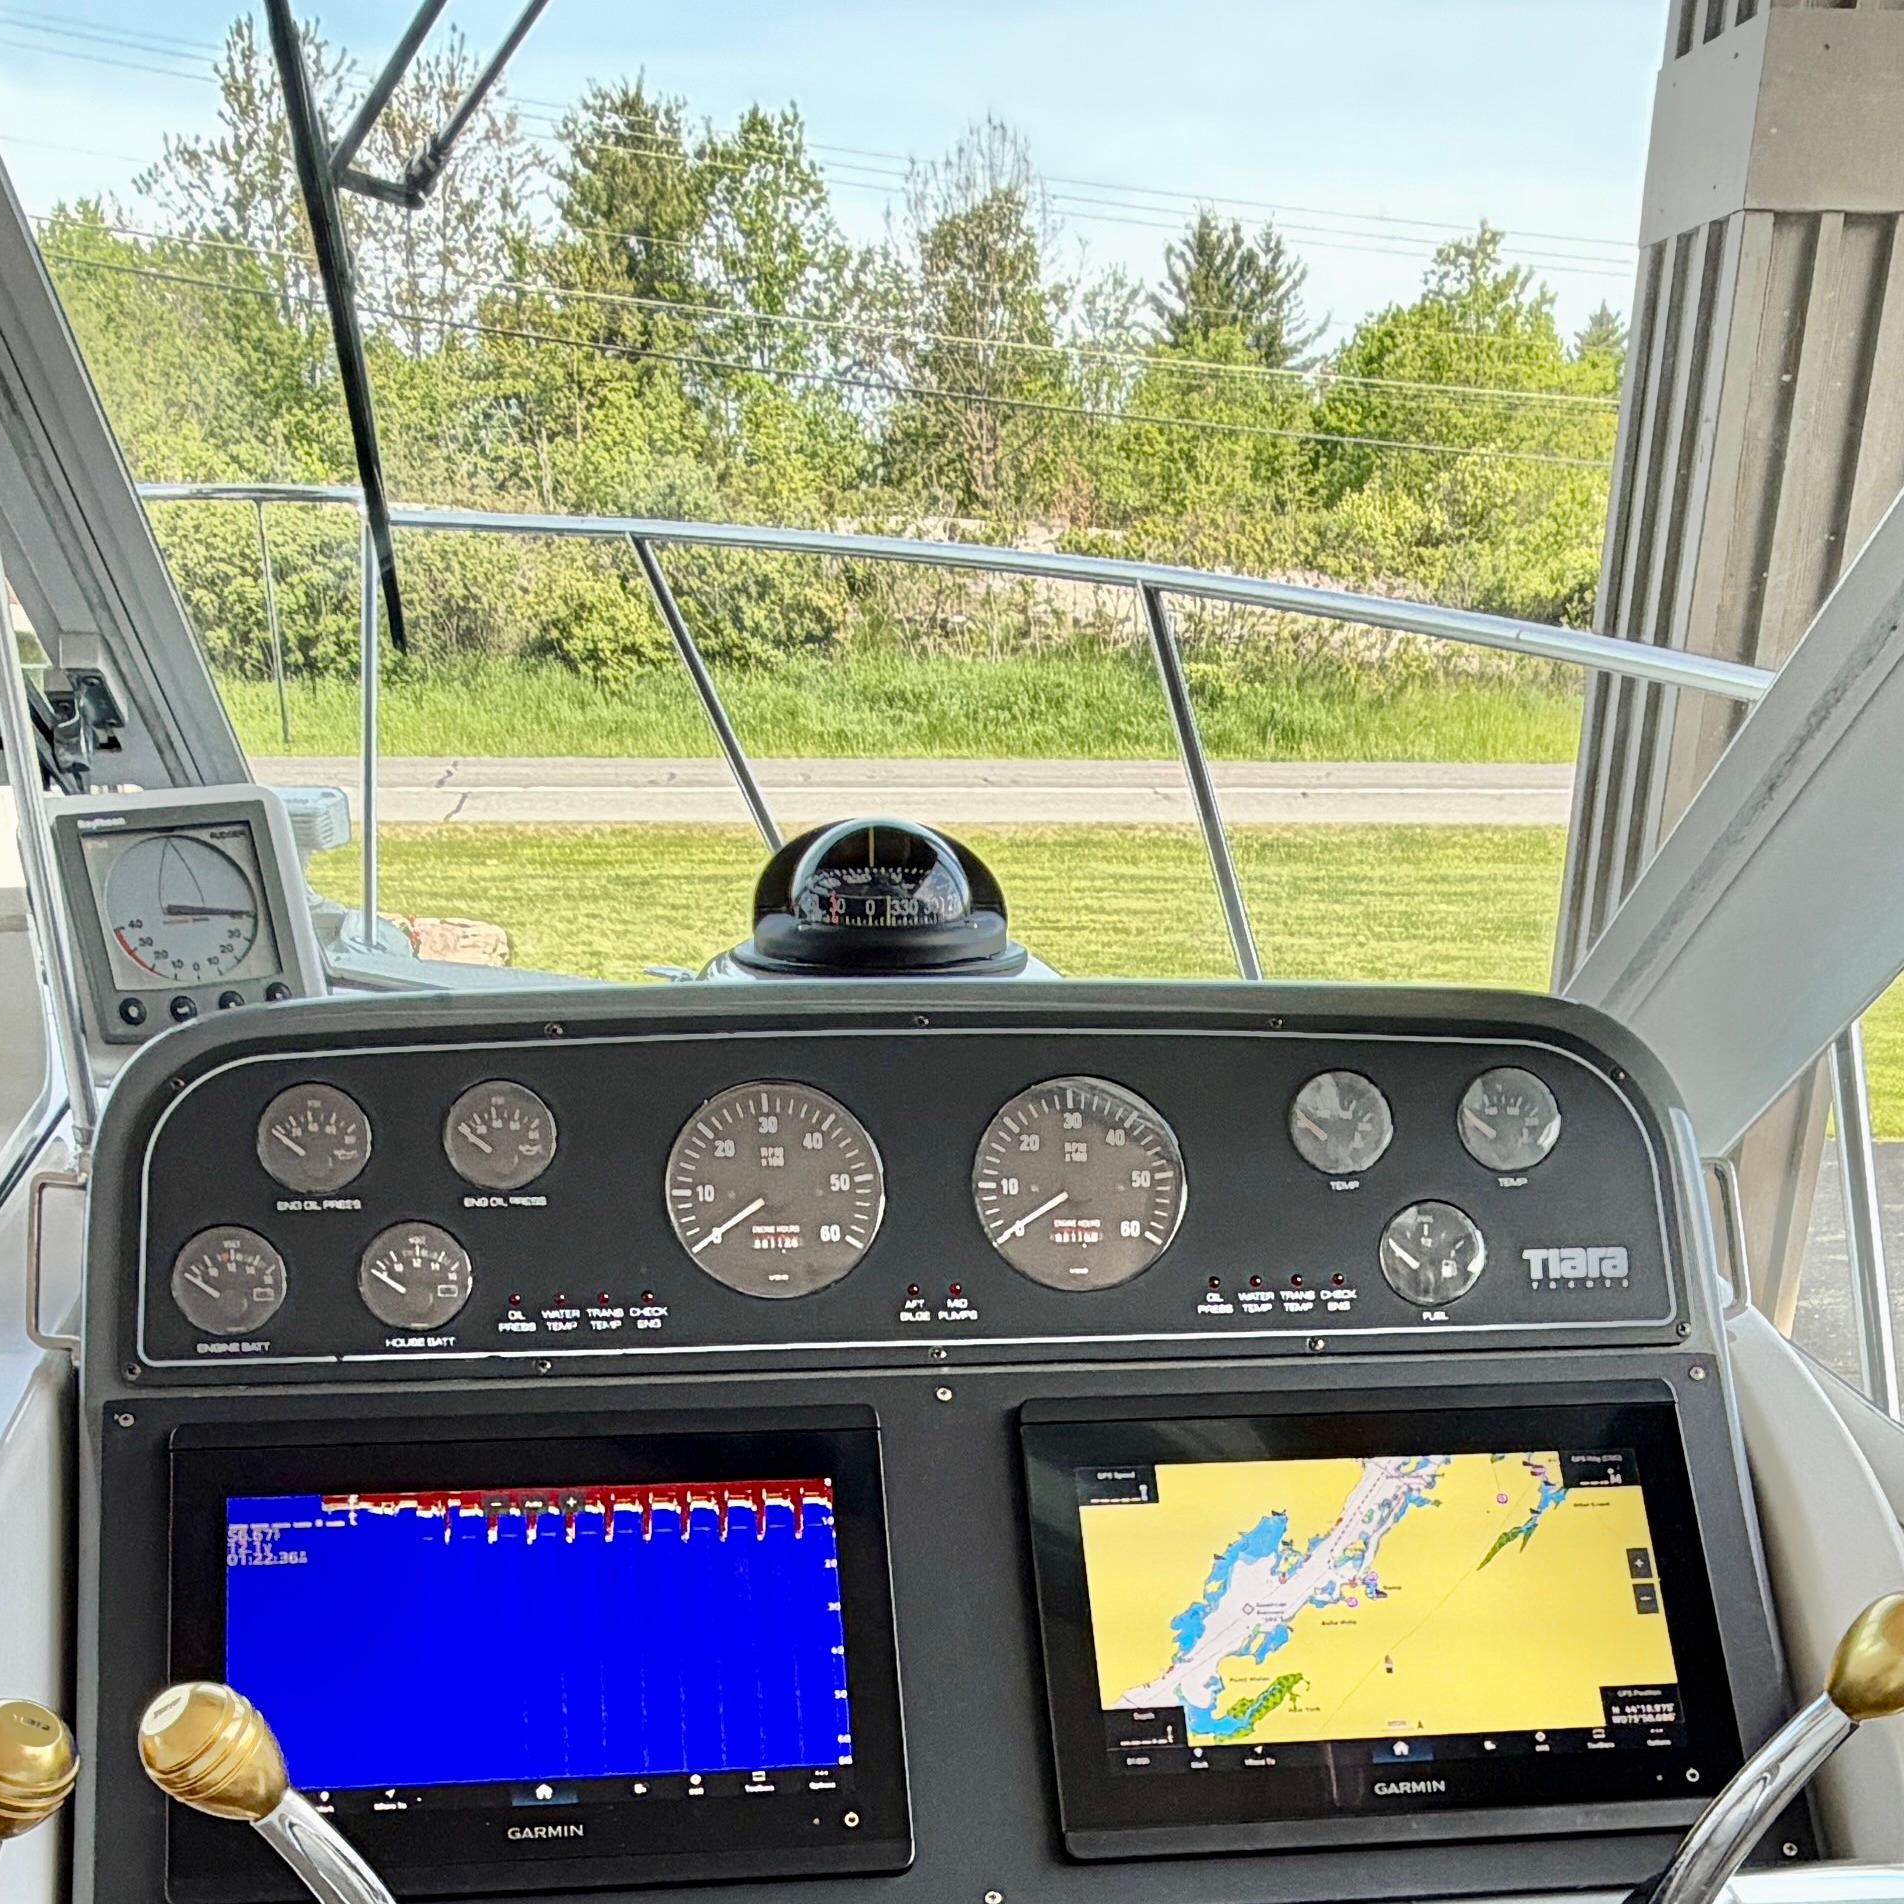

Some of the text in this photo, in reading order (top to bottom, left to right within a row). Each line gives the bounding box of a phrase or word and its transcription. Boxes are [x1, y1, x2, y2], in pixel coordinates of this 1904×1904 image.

[128, 919, 143, 929] 40
[138, 936, 154, 947] 30
[758, 1116, 778, 1134] 30
[1063, 1112, 1082, 1129] 30
[803, 1132, 823, 1150] 40
[1019, 1134, 1040, 1152] 20
[1105, 1129, 1125, 1146] 40
[714, 1139, 735, 1157] 20
[829, 1173, 850, 1191] 50
[1000, 1178, 1019, 1195] 10
[1131, 1170, 1151, 1188] 50
[1330, 1180, 1361, 1191] TEMP
[1498, 1177, 1528, 1188] TEMP
[696, 1184, 715, 1202] 10
[819, 1224, 841, 1242] 60
[1120, 1220, 1141, 1237] 60
[1238, 1291, 1275, 1301] WATER
[541, 1309, 581, 1319] WATER
[586, 1307, 624, 1318] TRANS
[629, 1306, 668, 1317] CHECK
[1423, 1311, 1449, 1321] FUEL
[546, 1321, 577, 1331] TEMP
[1374, 1780, 1446, 1795] GARMIN
[507, 1824, 584, 1840] GARMIN
